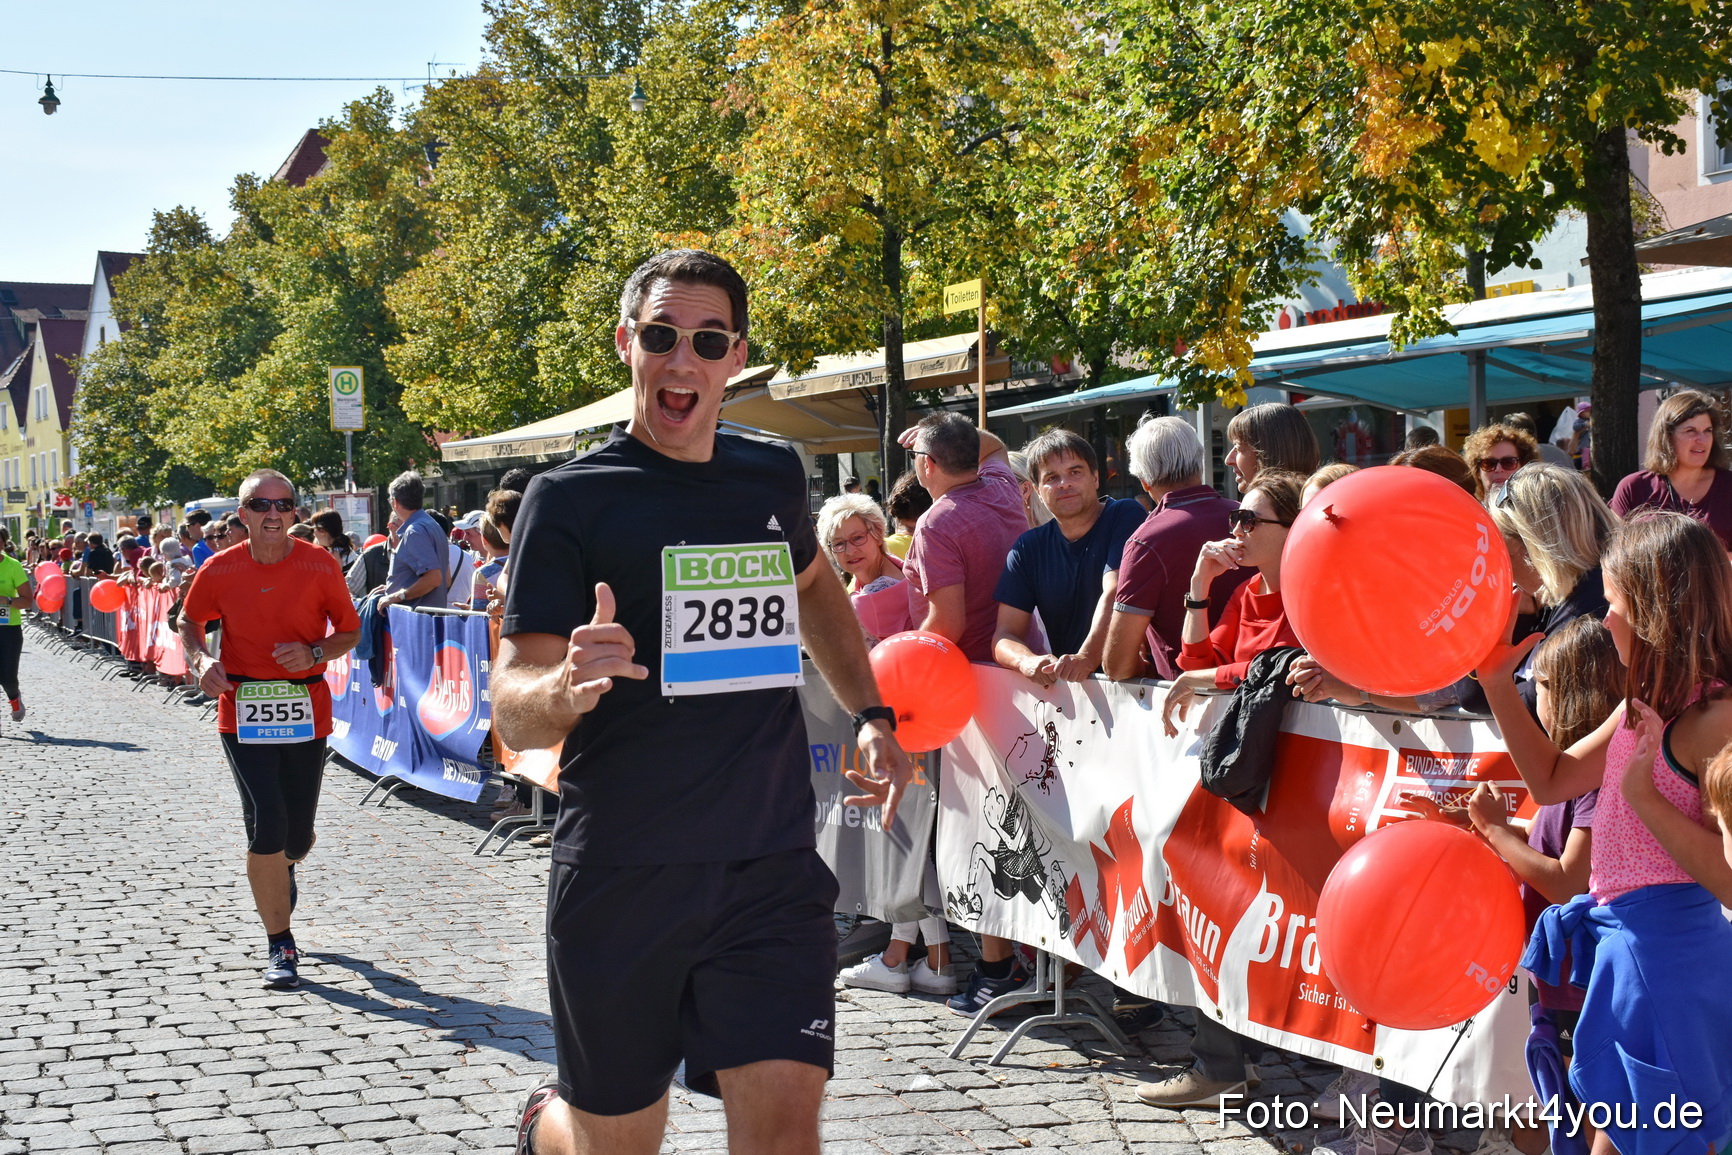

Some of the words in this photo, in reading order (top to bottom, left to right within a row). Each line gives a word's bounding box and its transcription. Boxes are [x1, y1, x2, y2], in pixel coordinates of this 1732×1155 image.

[950, 290, 979, 305] Toiletten
[677, 552, 785, 585] BOCK
[1425, 522, 1498, 637] RÖDL
[1419, 578, 1463, 630] energie
[683, 595, 785, 643] 2838
[884, 632, 946, 649] RÖDL
[918, 640, 948, 654] energie
[242, 685, 305, 698] BOCK
[245, 701, 305, 723] 2555
[257, 728, 295, 737] PETER
[1405, 755, 1481, 776] BINDESTRICKE
[1345, 807, 1359, 832] Seit
[1356, 771, 1375, 802] 1929
[1249, 852, 1257, 870] Seit
[1160, 865, 1221, 965] Braun
[1248, 891, 1322, 976] Bra
[1465, 961, 1508, 994] RÖ
[1298, 982, 1331, 1006] Sicher
[800, 1028, 815, 1036] PRO
